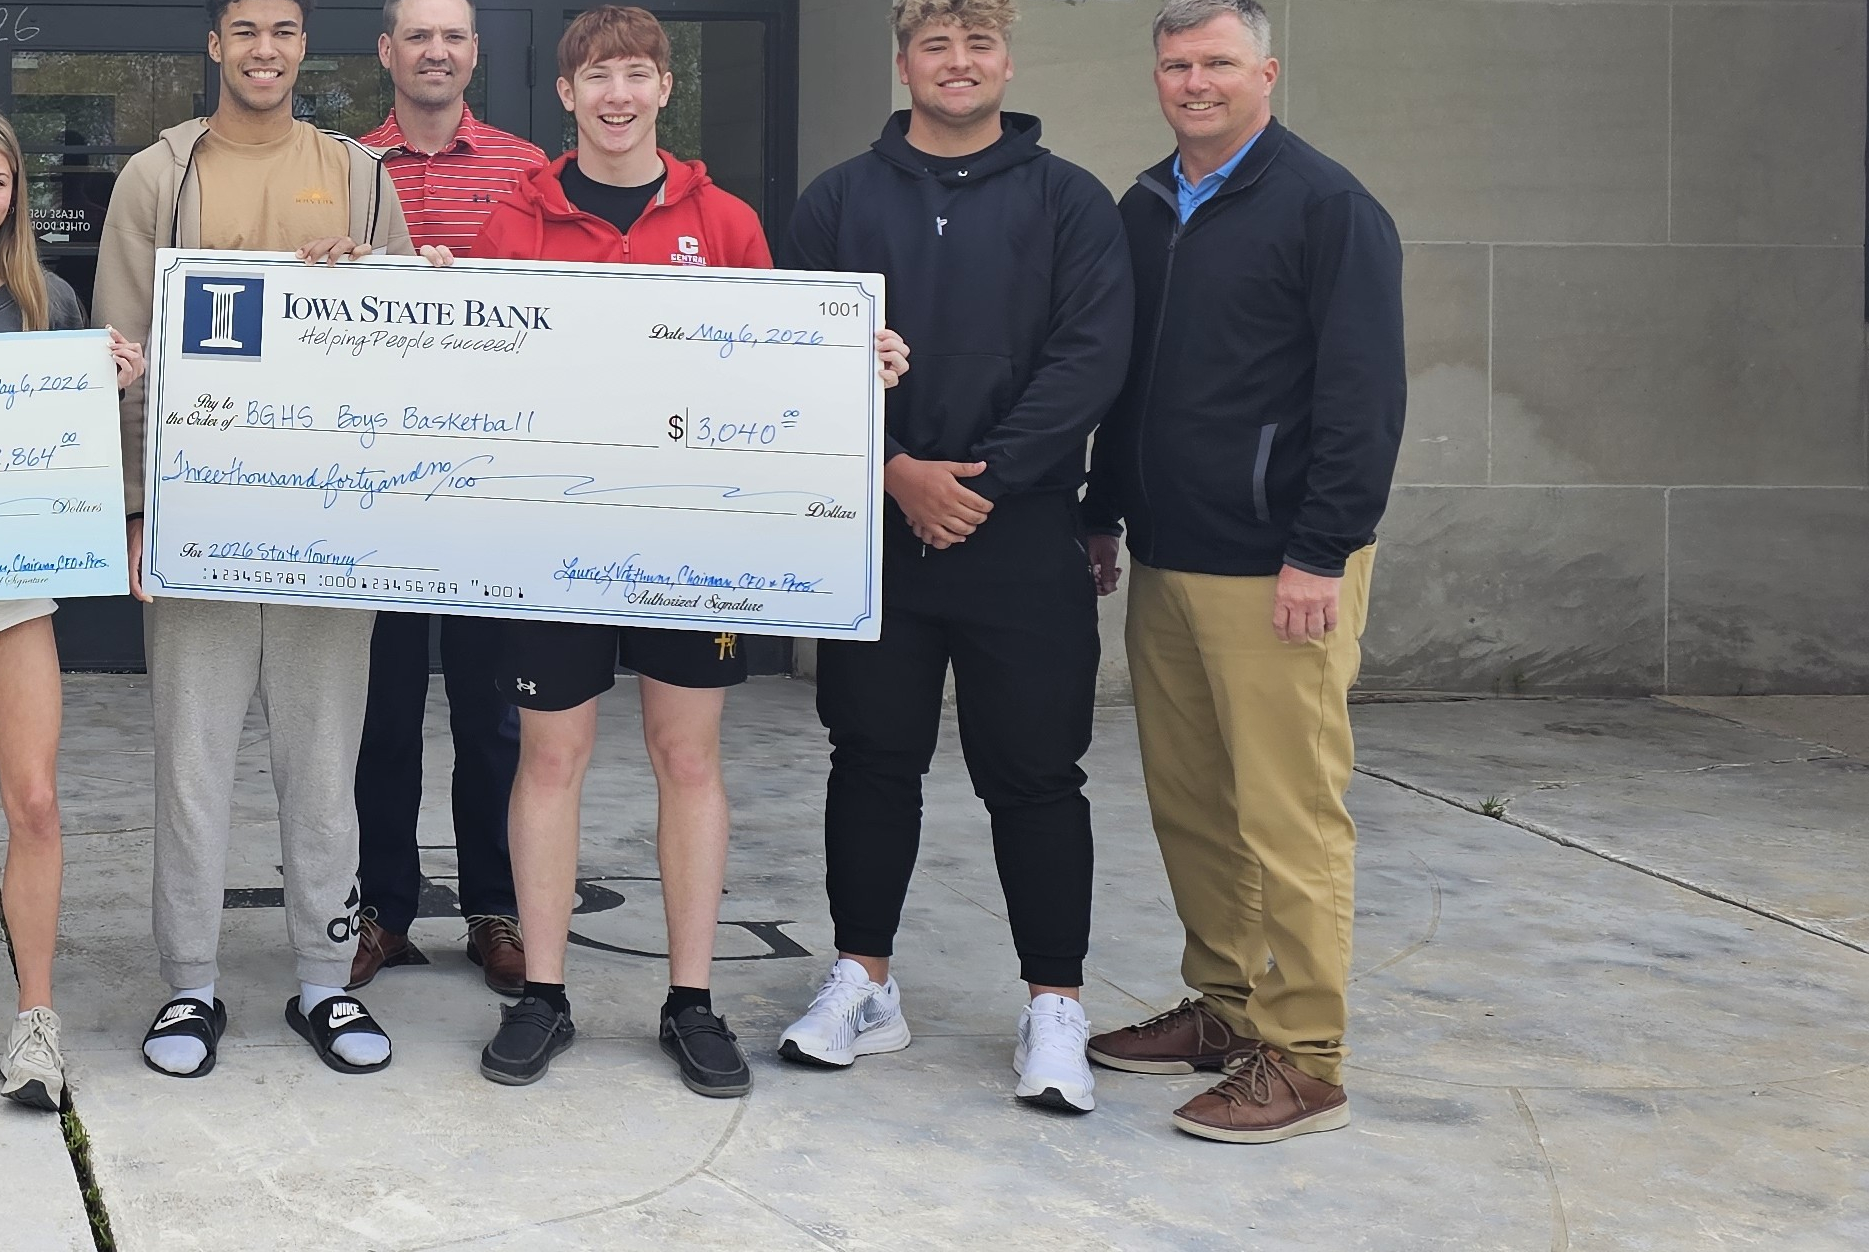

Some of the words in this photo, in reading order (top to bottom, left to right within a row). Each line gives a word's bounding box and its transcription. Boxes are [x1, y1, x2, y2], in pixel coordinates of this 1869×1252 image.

[678, 235, 699, 255] C
[670, 253, 707, 265] CENTRAL
[282, 292, 355, 322] IOWA
[359, 295, 455, 326] STATE
[463, 299, 554, 331] BANK
[817, 301, 861, 318] 1001
[297, 326, 370, 358] Helping
[368, 329, 435, 359] People
[440, 331, 529, 355] Succeed!
[647, 322, 686, 341] Date
[685, 322, 734, 359] May
[765, 327, 825, 346] 2026
[40, 373, 89, 393] 2026
[193, 392, 220, 413] Pay
[220, 395, 234, 411] to
[165, 411, 185, 427] the
[185, 411, 220, 428] Order
[219, 413, 239, 432] of
[245, 399, 315, 430] BGHS
[336, 404, 390, 449] Boys
[51, 498, 103, 516] Dollars
[803, 500, 858, 521] Dollars
[179, 541, 204, 559] For
[207, 541, 254, 560] 2026
[256, 541, 302, 563] State
[5, 574, 50, 588] Signature
[627, 589, 701, 610] Authorized
[704, 592, 765, 614] Signature
[163, 1002, 197, 1020] NIKE
[332, 1002, 361, 1018] NIKE
